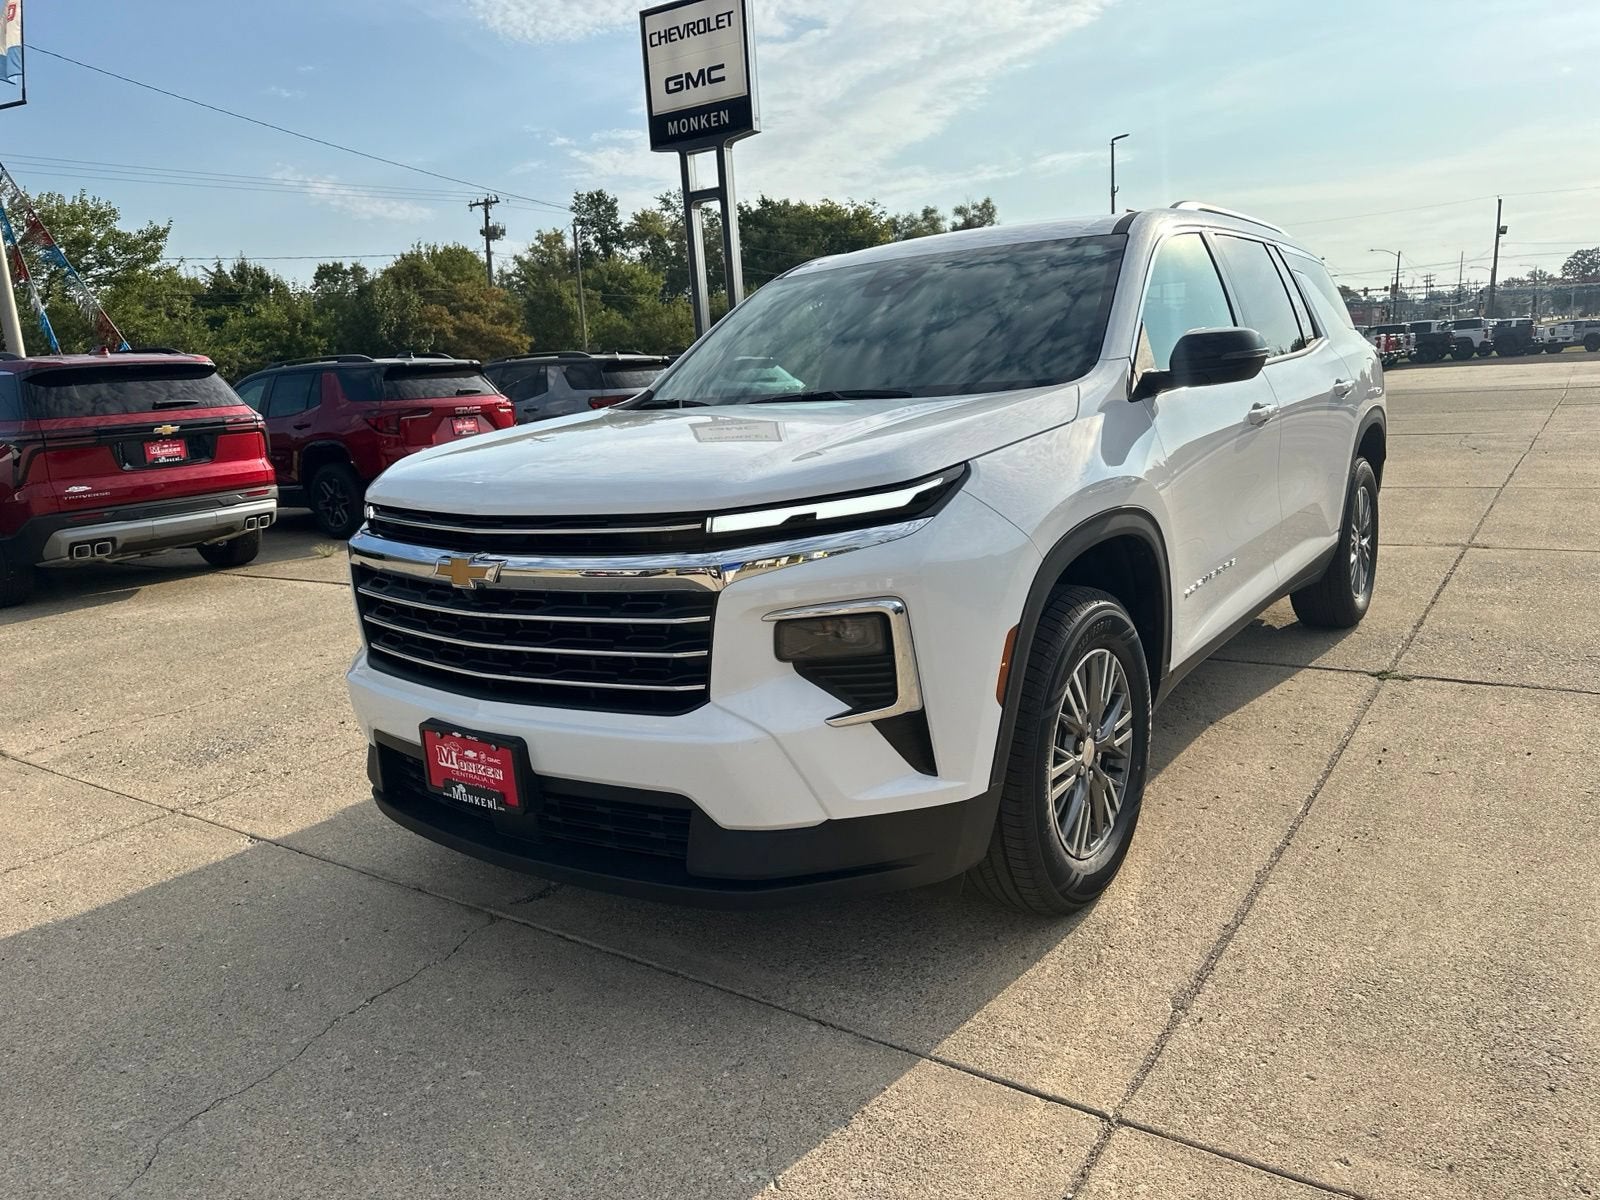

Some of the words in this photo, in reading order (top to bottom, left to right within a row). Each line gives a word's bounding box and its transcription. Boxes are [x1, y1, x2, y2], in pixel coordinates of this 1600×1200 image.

[649, 10, 734, 48] CHEVROLET
[664, 63, 726, 95] GMC
[667, 109, 729, 136] MONKEN
[455, 406, 481, 414] GMC
[435, 744, 504, 781] MONKEN
[486, 756, 502, 765] GMC
